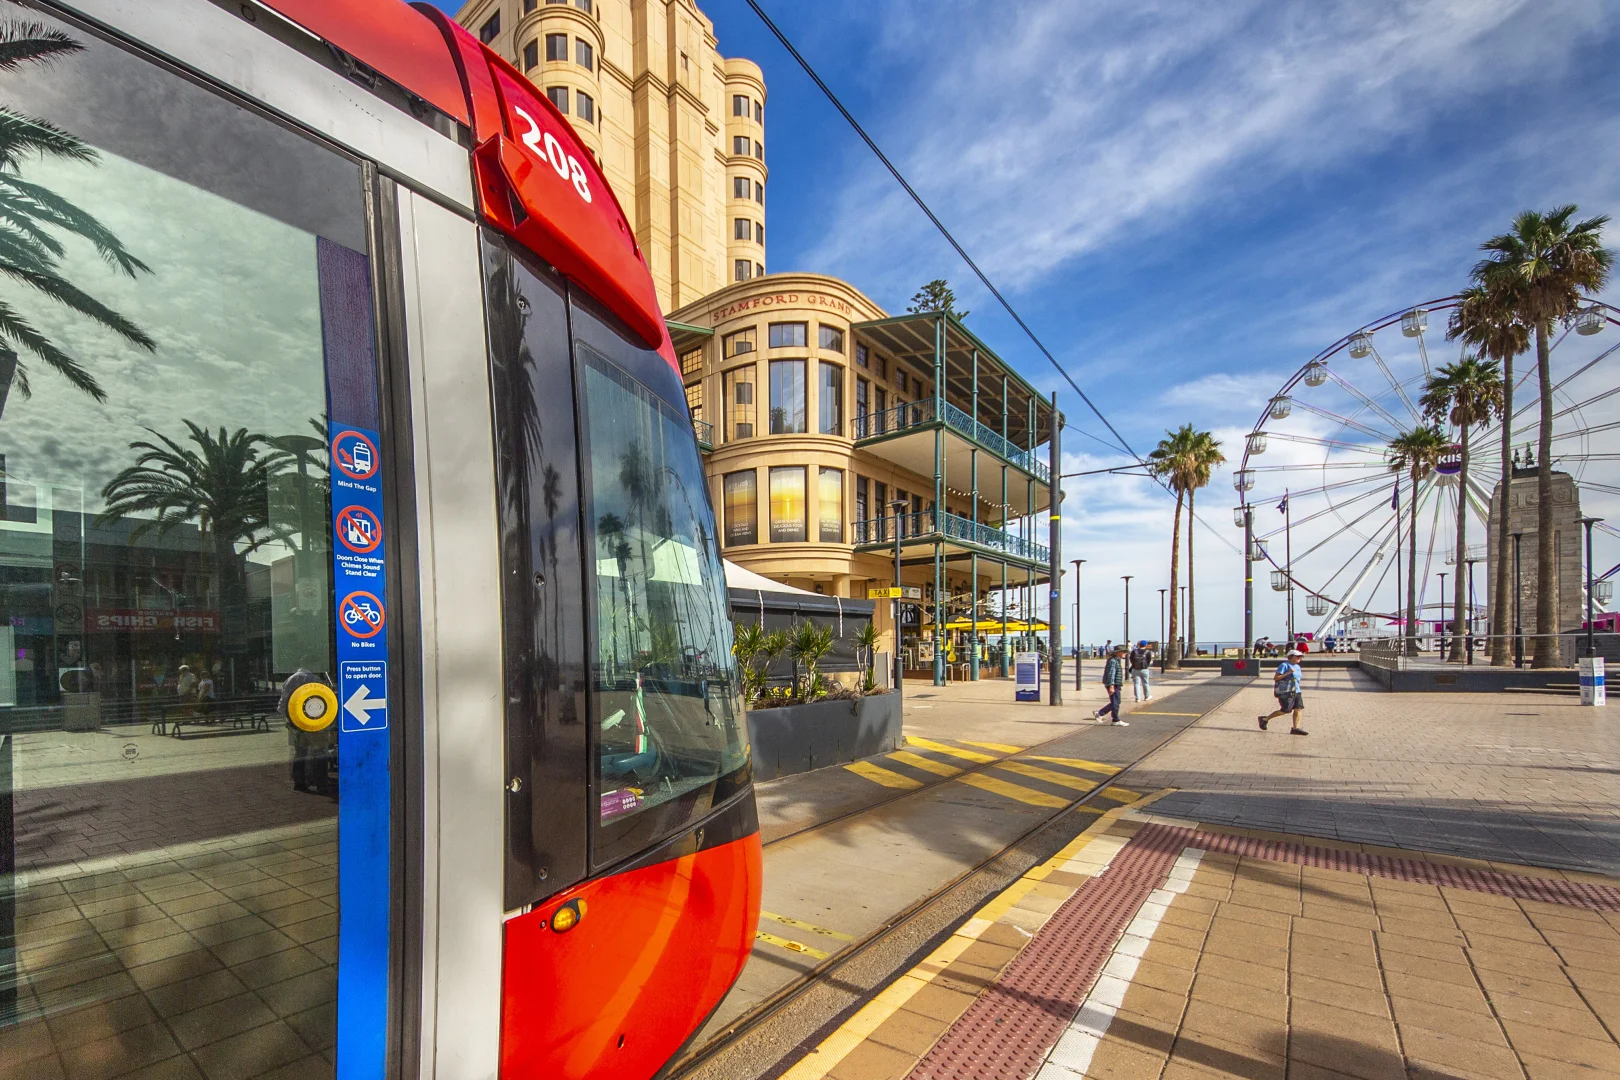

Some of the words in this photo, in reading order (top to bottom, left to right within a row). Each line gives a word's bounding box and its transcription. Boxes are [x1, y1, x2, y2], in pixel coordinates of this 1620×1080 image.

[514, 105, 592, 204] 208
[713, 294, 799, 322] STAMFORD
[807, 294, 852, 315] GRAND
[337, 480, 353, 488] Mind
[365, 485, 377, 493] Gap
